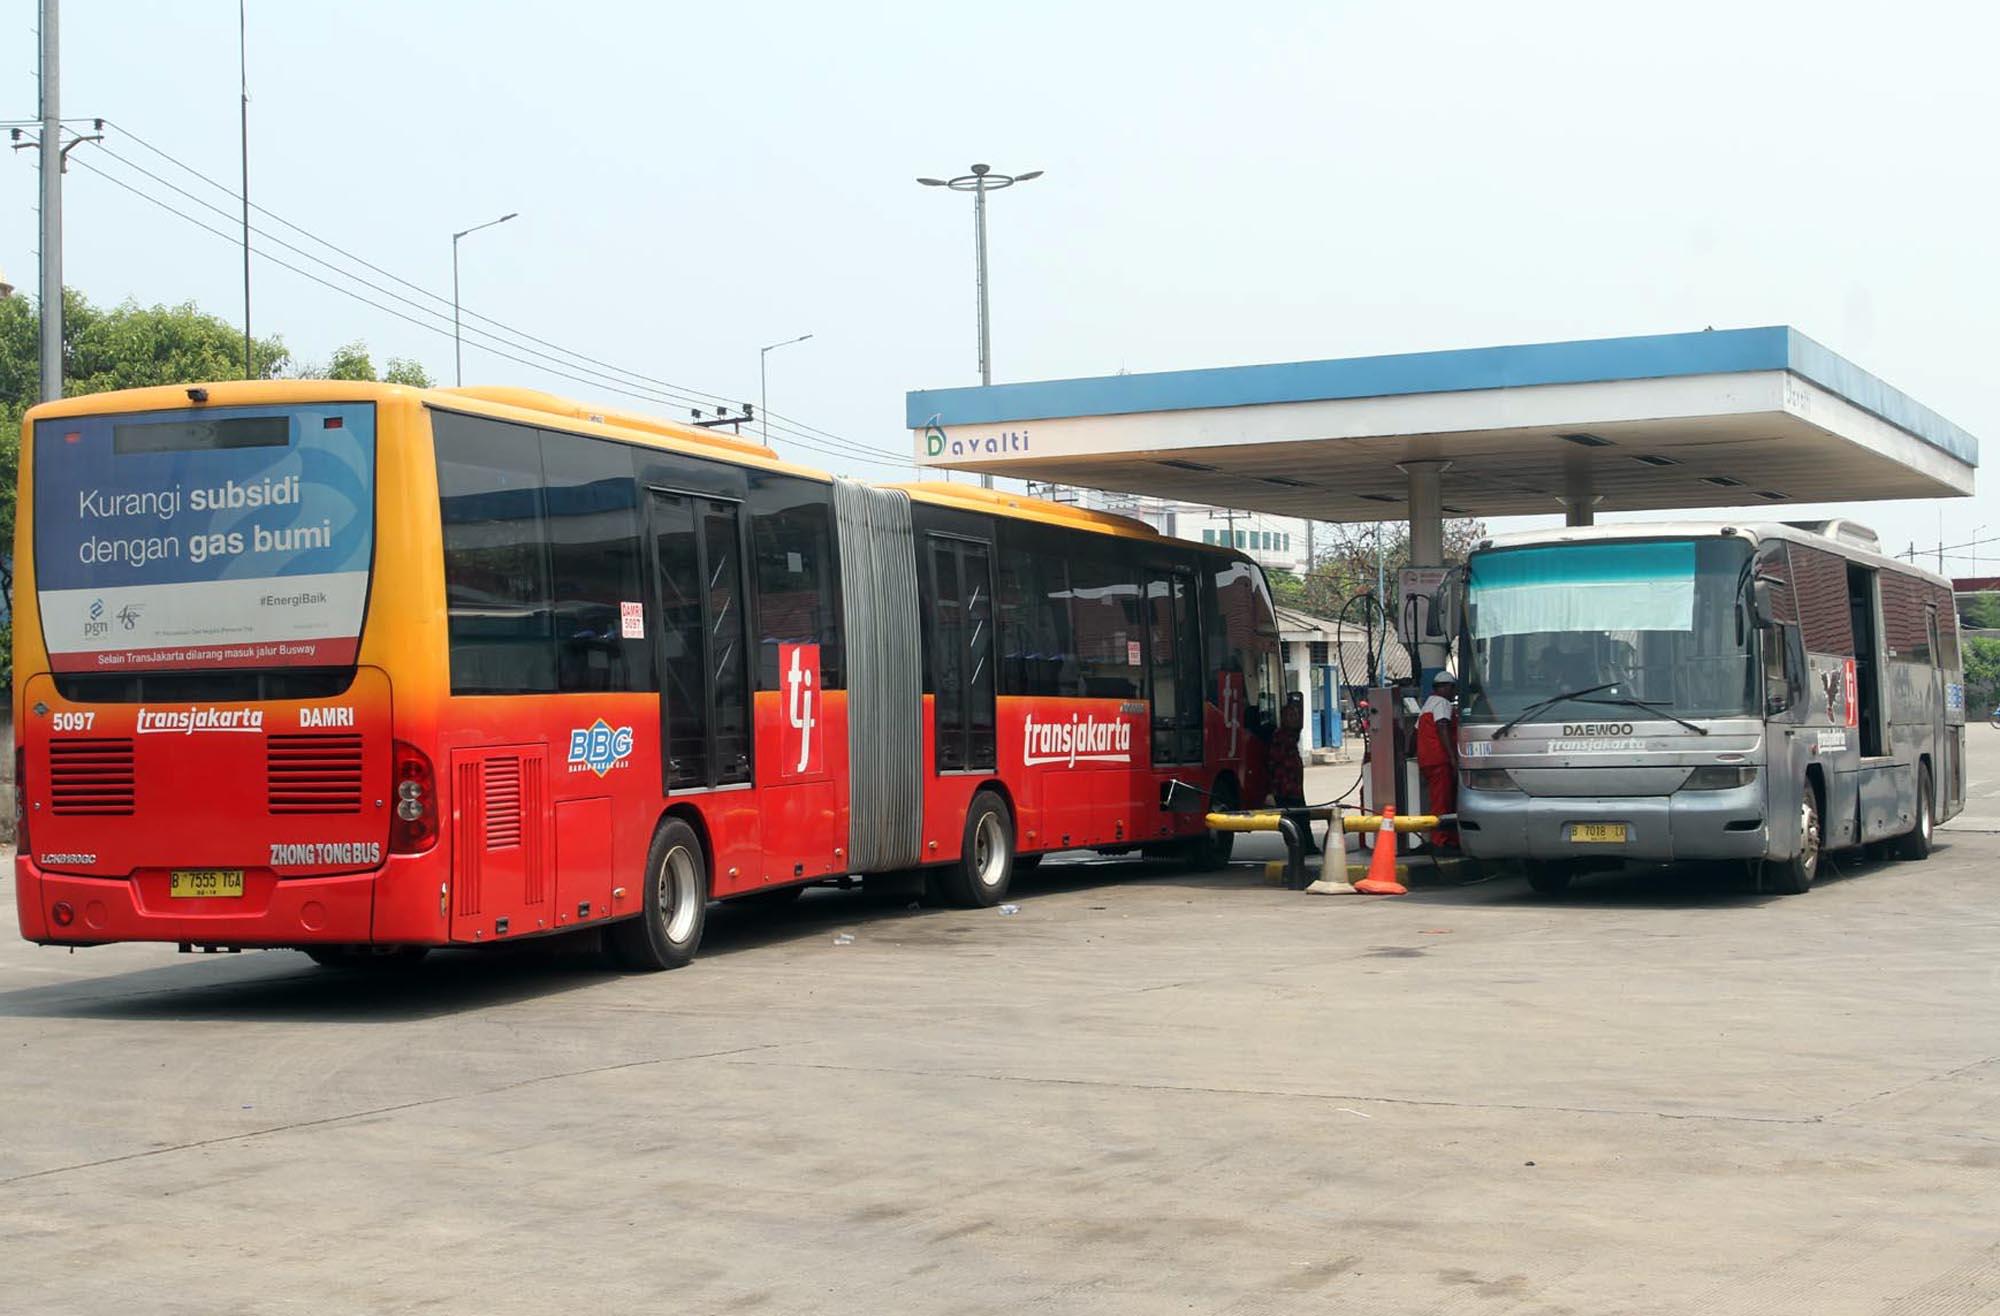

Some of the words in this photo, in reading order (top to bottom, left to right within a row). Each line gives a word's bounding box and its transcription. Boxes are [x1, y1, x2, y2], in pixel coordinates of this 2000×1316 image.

[927, 429, 1029, 457] Davalti
[79, 483, 180, 520] Kurangi
[190, 475, 299, 510] subsidi
[79, 535, 179, 567] dengan
[189, 532, 245, 563] gas
[253, 519, 331, 553] bumi
[260, 591, 327, 607] #EnergiBaik
[84, 621, 108, 636] pgn
[98, 653, 125, 664] Selain
[126, 649, 184, 663] TransJakarta
[185, 648, 222, 661] dilarang
[224, 647, 255, 660] masuk
[256, 645, 277, 658] jalur
[279, 644, 316, 656] Busway
[53, 711, 95, 731] 5097
[137, 707, 263, 735] transjakarta
[300, 707, 354, 728] DAMRI
[788, 647, 815, 773] tj
[1024, 713, 1131, 768] transjakarta
[1563, 724, 1633, 736] DAEWOO
[568, 726, 634, 762] BBG
[1571, 825, 1578, 837] B
[270, 844, 315, 865] ZHONG
[316, 843, 352, 864] TONG
[353, 842, 380, 863] BUS
[172, 873, 180, 889] B
[189, 873, 217, 889] 7555
[223, 872, 241, 888] TGA
